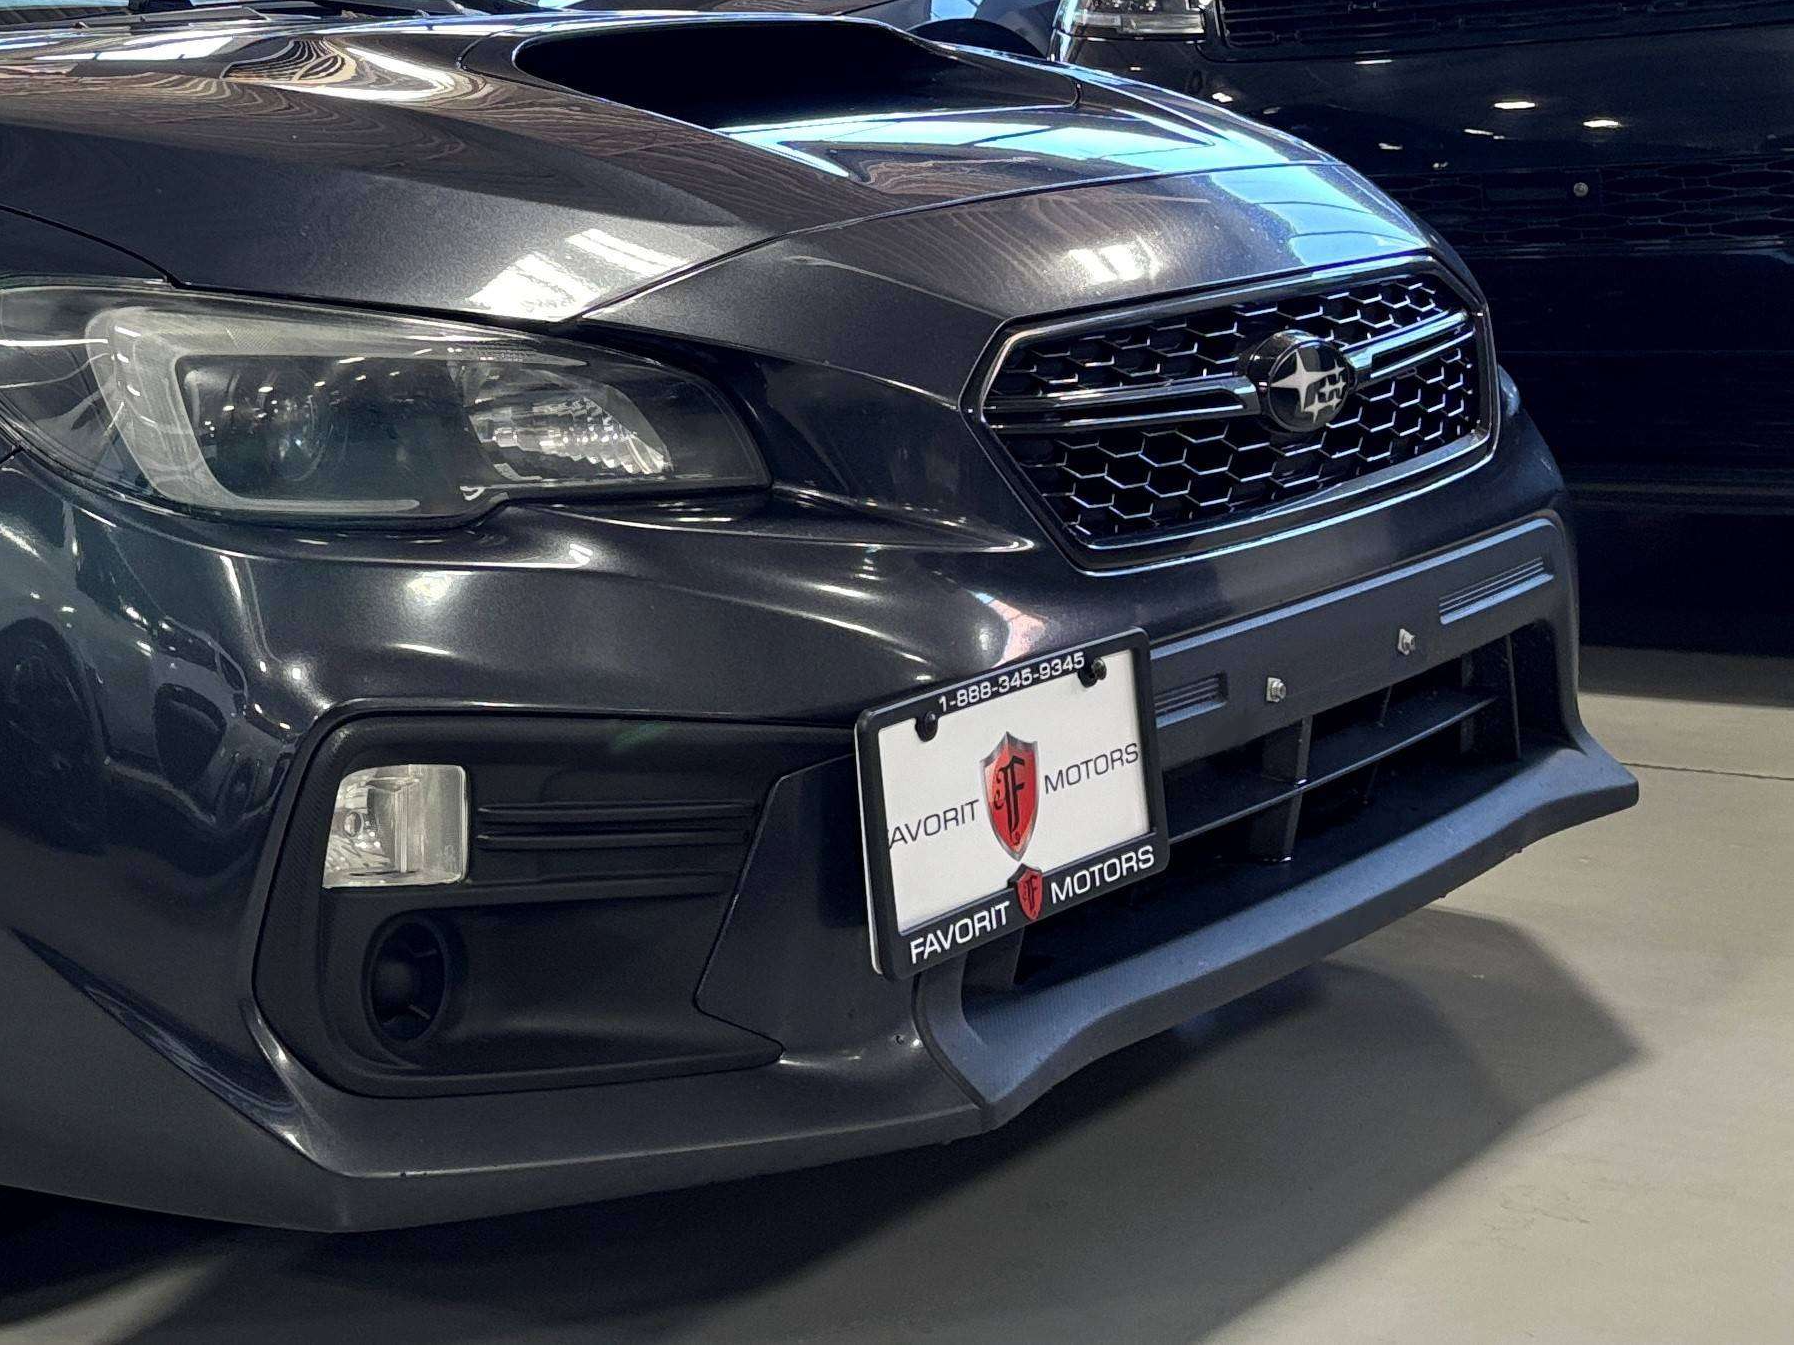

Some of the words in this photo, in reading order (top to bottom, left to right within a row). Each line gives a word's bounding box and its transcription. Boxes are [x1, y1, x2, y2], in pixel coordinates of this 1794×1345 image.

[938, 652, 1086, 713] 1-888-345-9345
[887, 799, 980, 850] AVORIT
[1044, 742, 1139, 794] MOTORS
[909, 901, 1010, 964] FAVORIT
[1050, 845, 1155, 905] MOTORS
